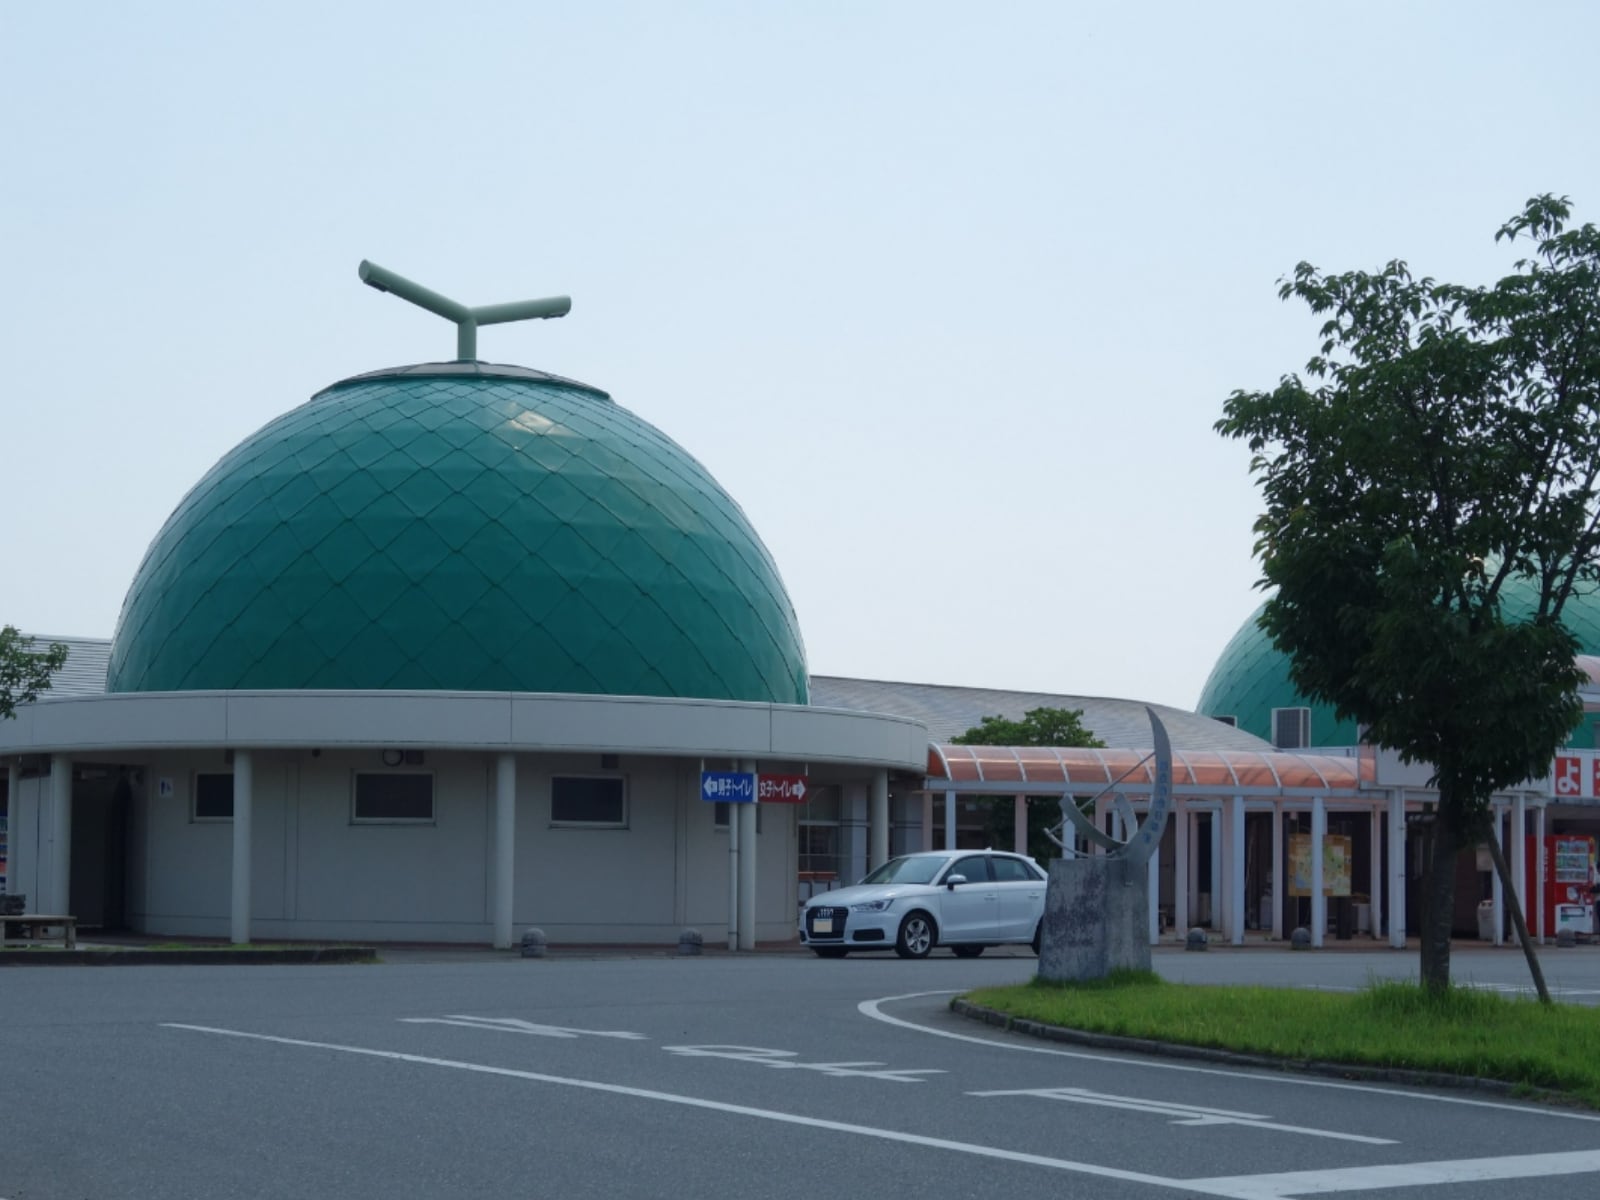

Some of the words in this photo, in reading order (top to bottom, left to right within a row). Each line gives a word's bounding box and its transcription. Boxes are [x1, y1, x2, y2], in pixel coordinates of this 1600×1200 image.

[717, 778, 752, 796] 男子トイレ
[760, 780, 791, 797] 女子トイレ
